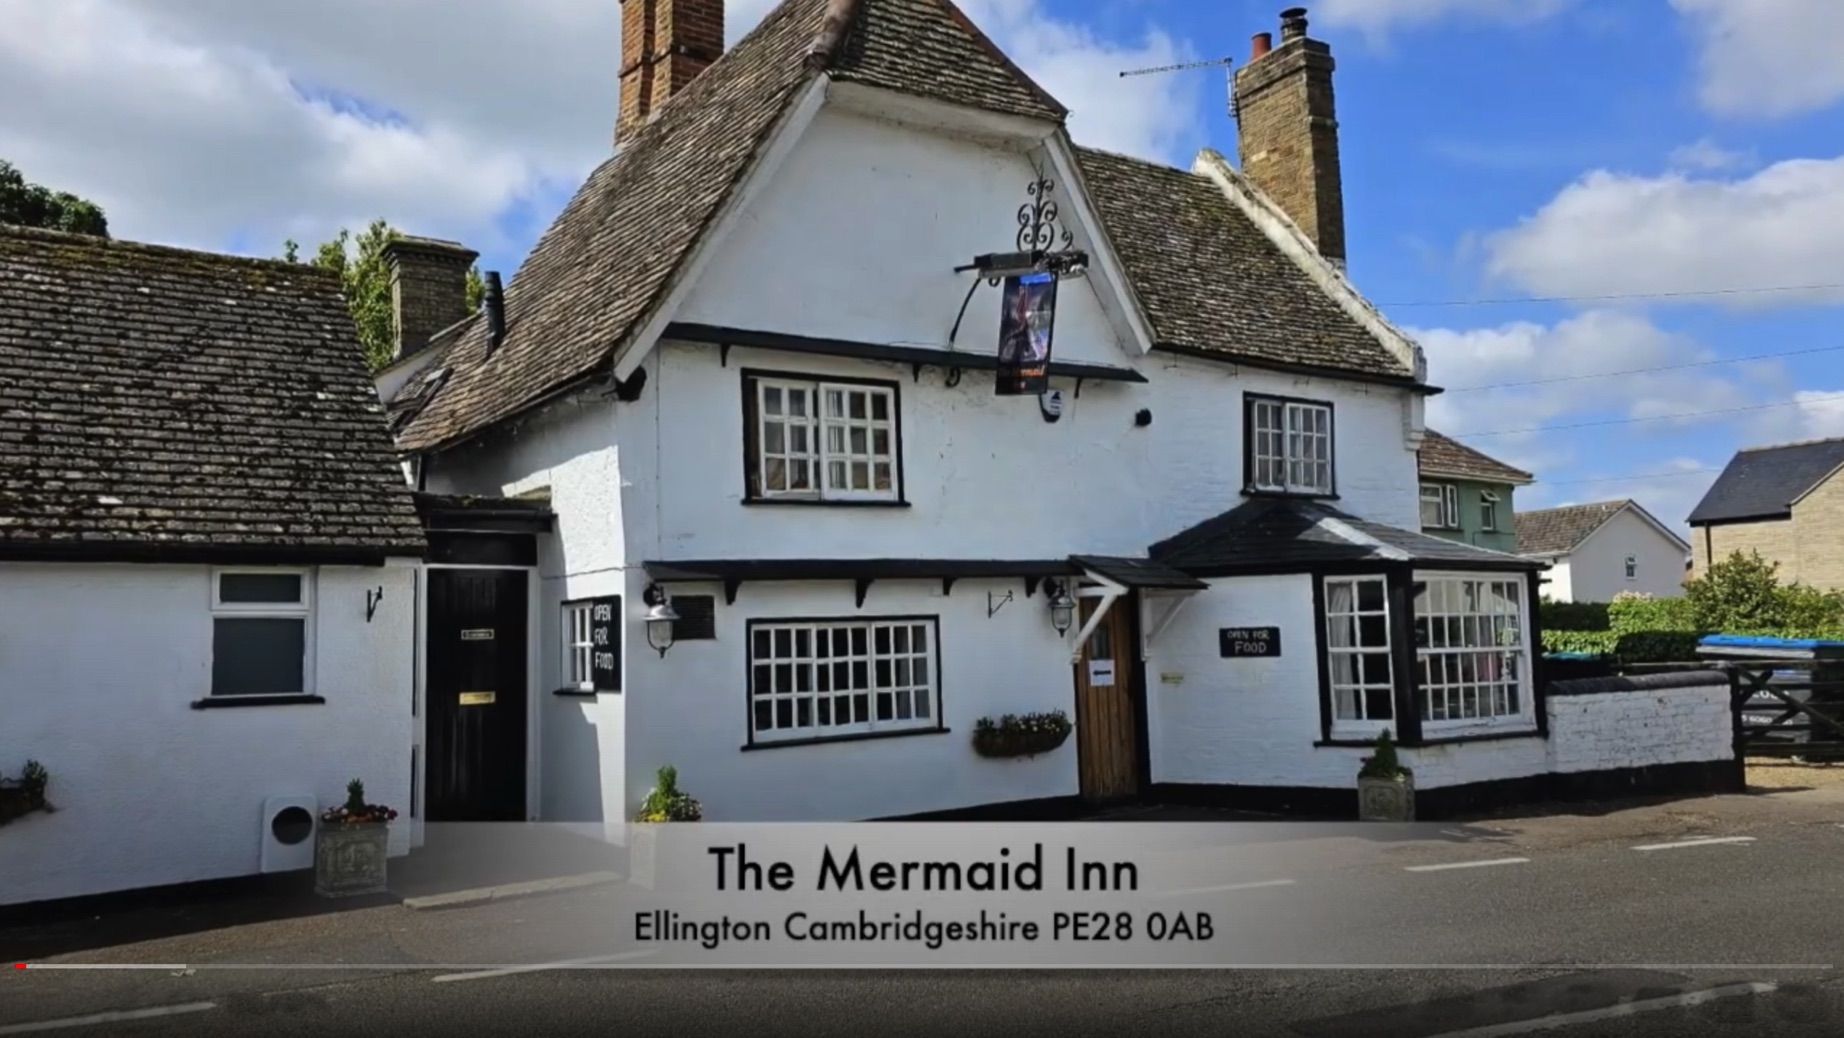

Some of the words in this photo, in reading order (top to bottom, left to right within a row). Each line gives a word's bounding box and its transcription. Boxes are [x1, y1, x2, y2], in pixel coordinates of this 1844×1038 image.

[594, 604, 612, 621] OPEN
[594, 627, 609, 645] FOR
[1226, 630, 1249, 639] OPEN
[1252, 629, 1270, 640] FOR
[1234, 640, 1267, 654] FOOD
[595, 652, 614, 670] FOOD
